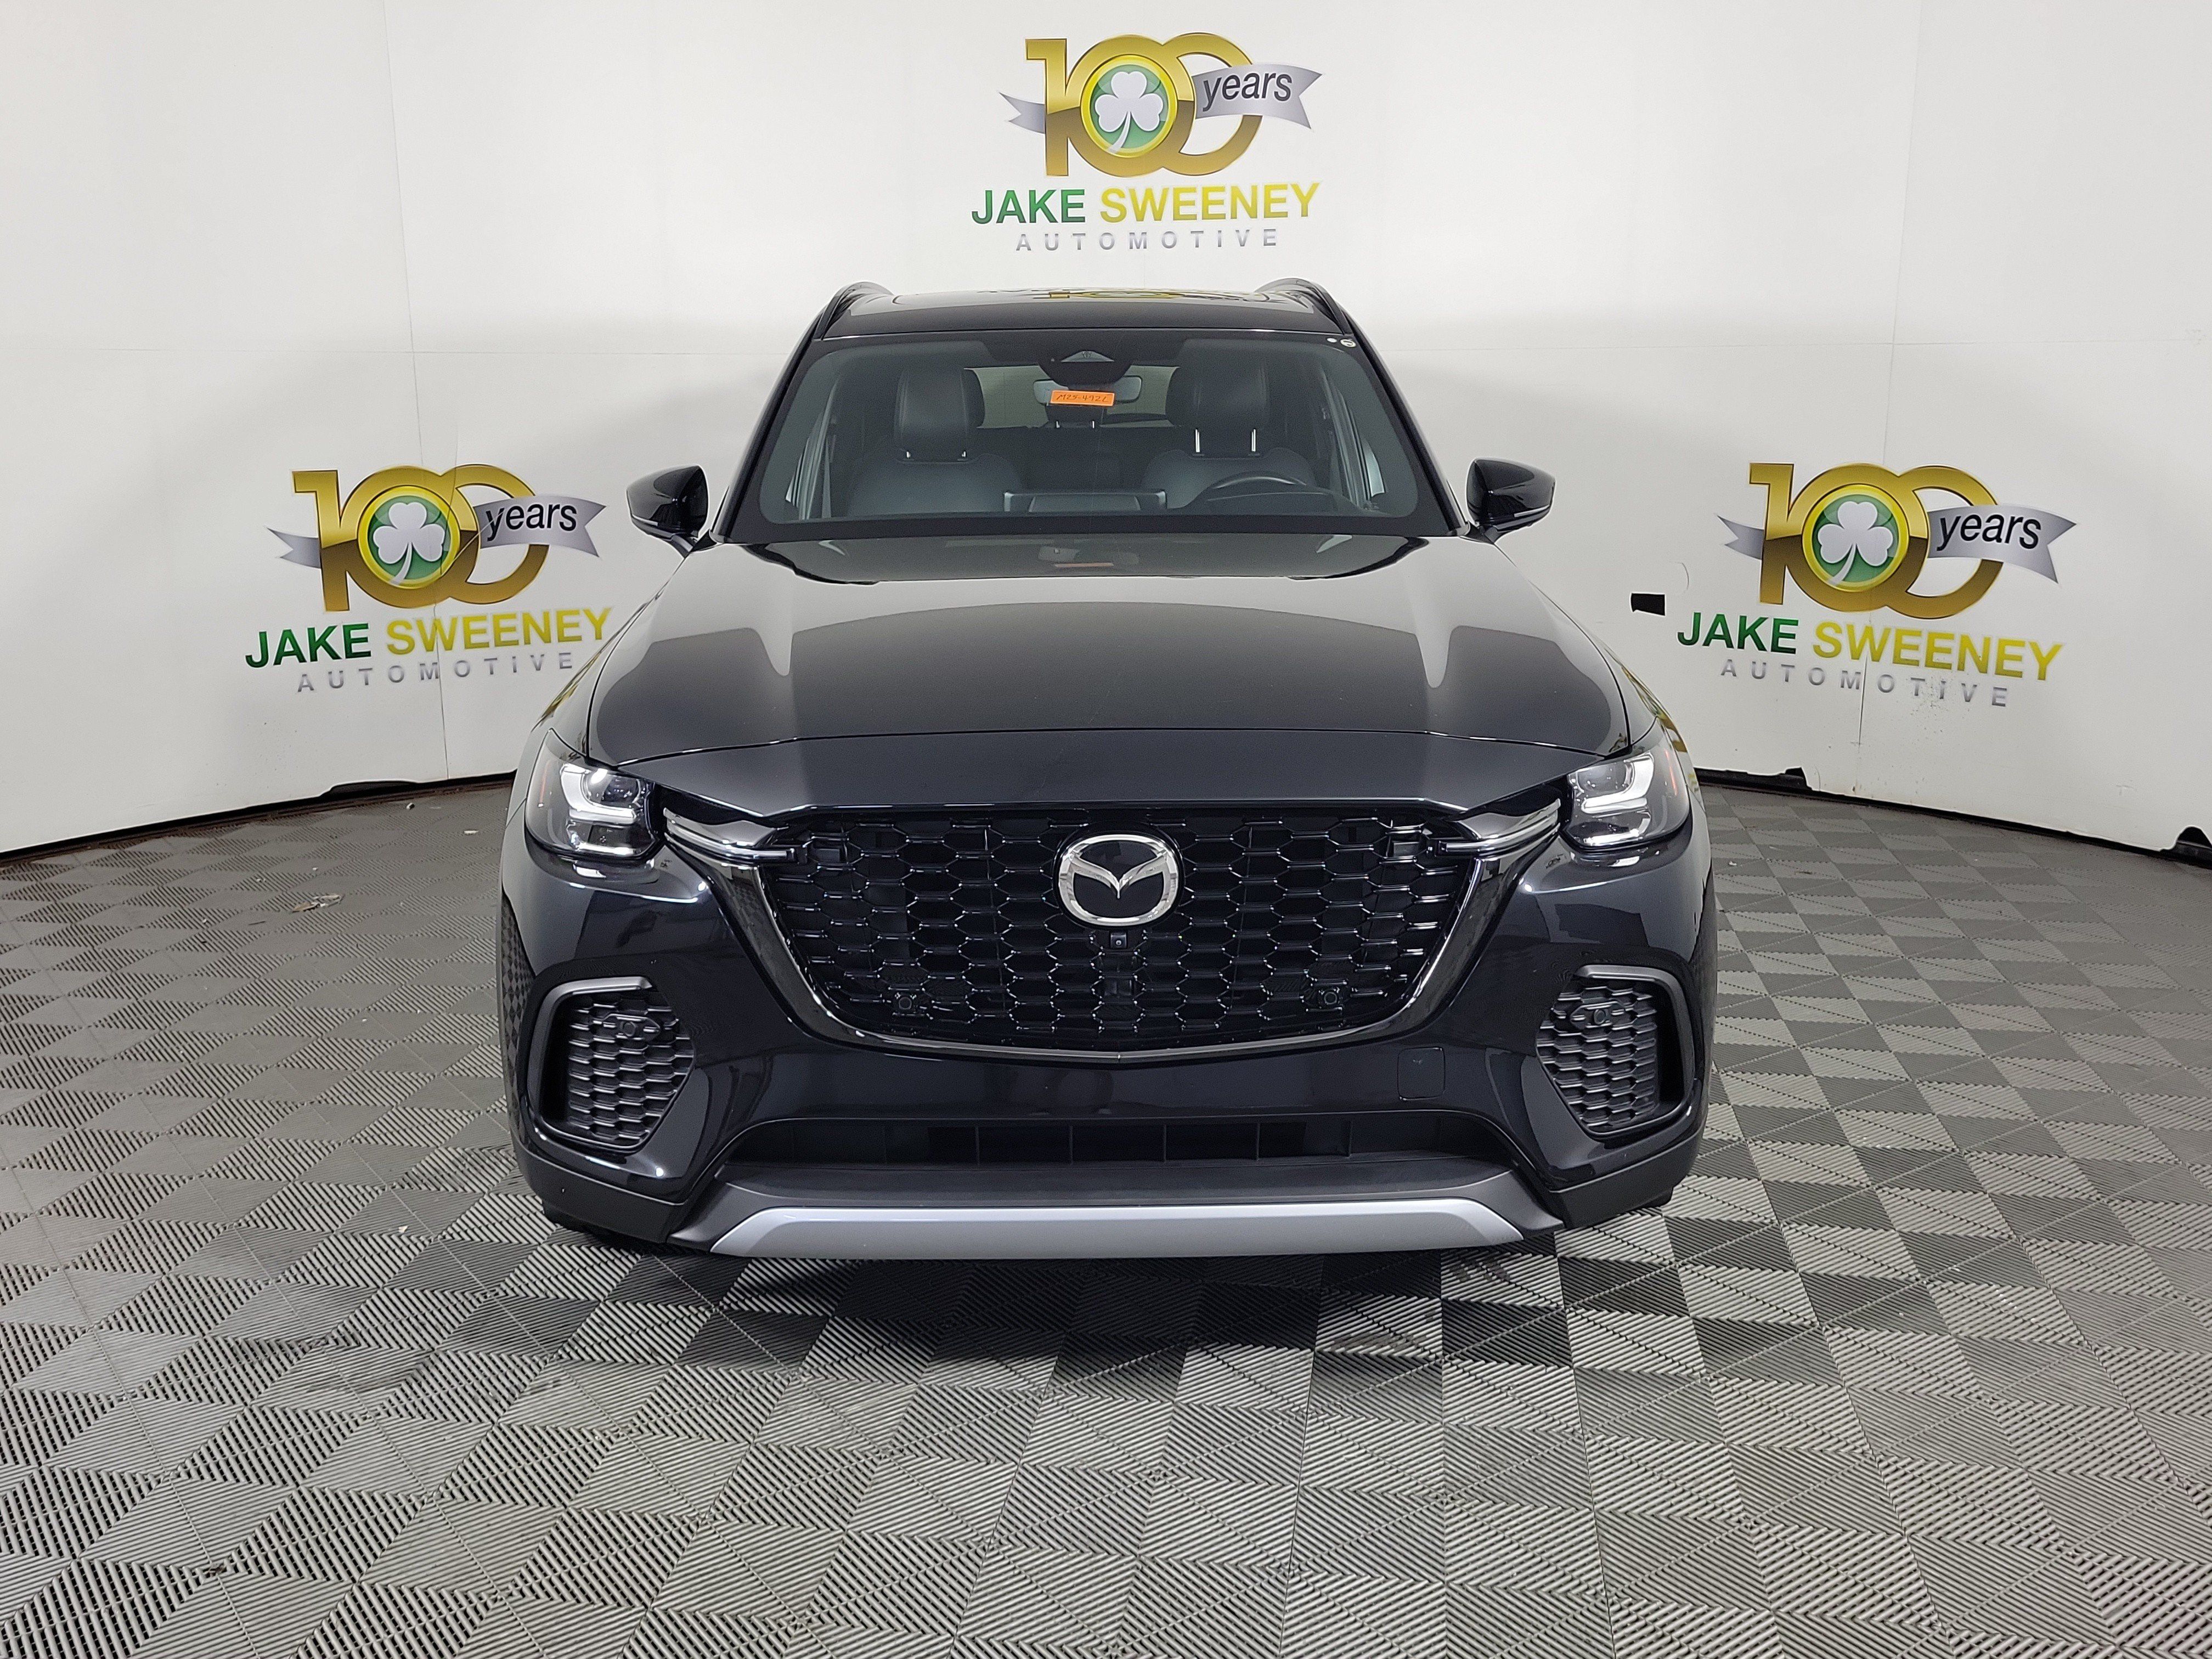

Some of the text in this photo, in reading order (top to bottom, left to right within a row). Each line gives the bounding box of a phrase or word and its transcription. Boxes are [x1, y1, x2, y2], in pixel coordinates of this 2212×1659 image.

[1025, 32, 1293, 178] 100 years
[972, 182, 1320, 224] JAKE SWEENEY
[1015, 228, 1277, 252] AUTOMOTIVE
[292, 464, 577, 612] 100 years
[1749, 462, 2041, 619] 100 years
[246, 607, 612, 668] JAKE SWEENEY
[1678, 612, 2063, 680] JAKE SWEENEY
[297, 652, 572, 693] AUTOMOTIVE
[1720, 659, 2008, 707] AUTOMOTIVE
